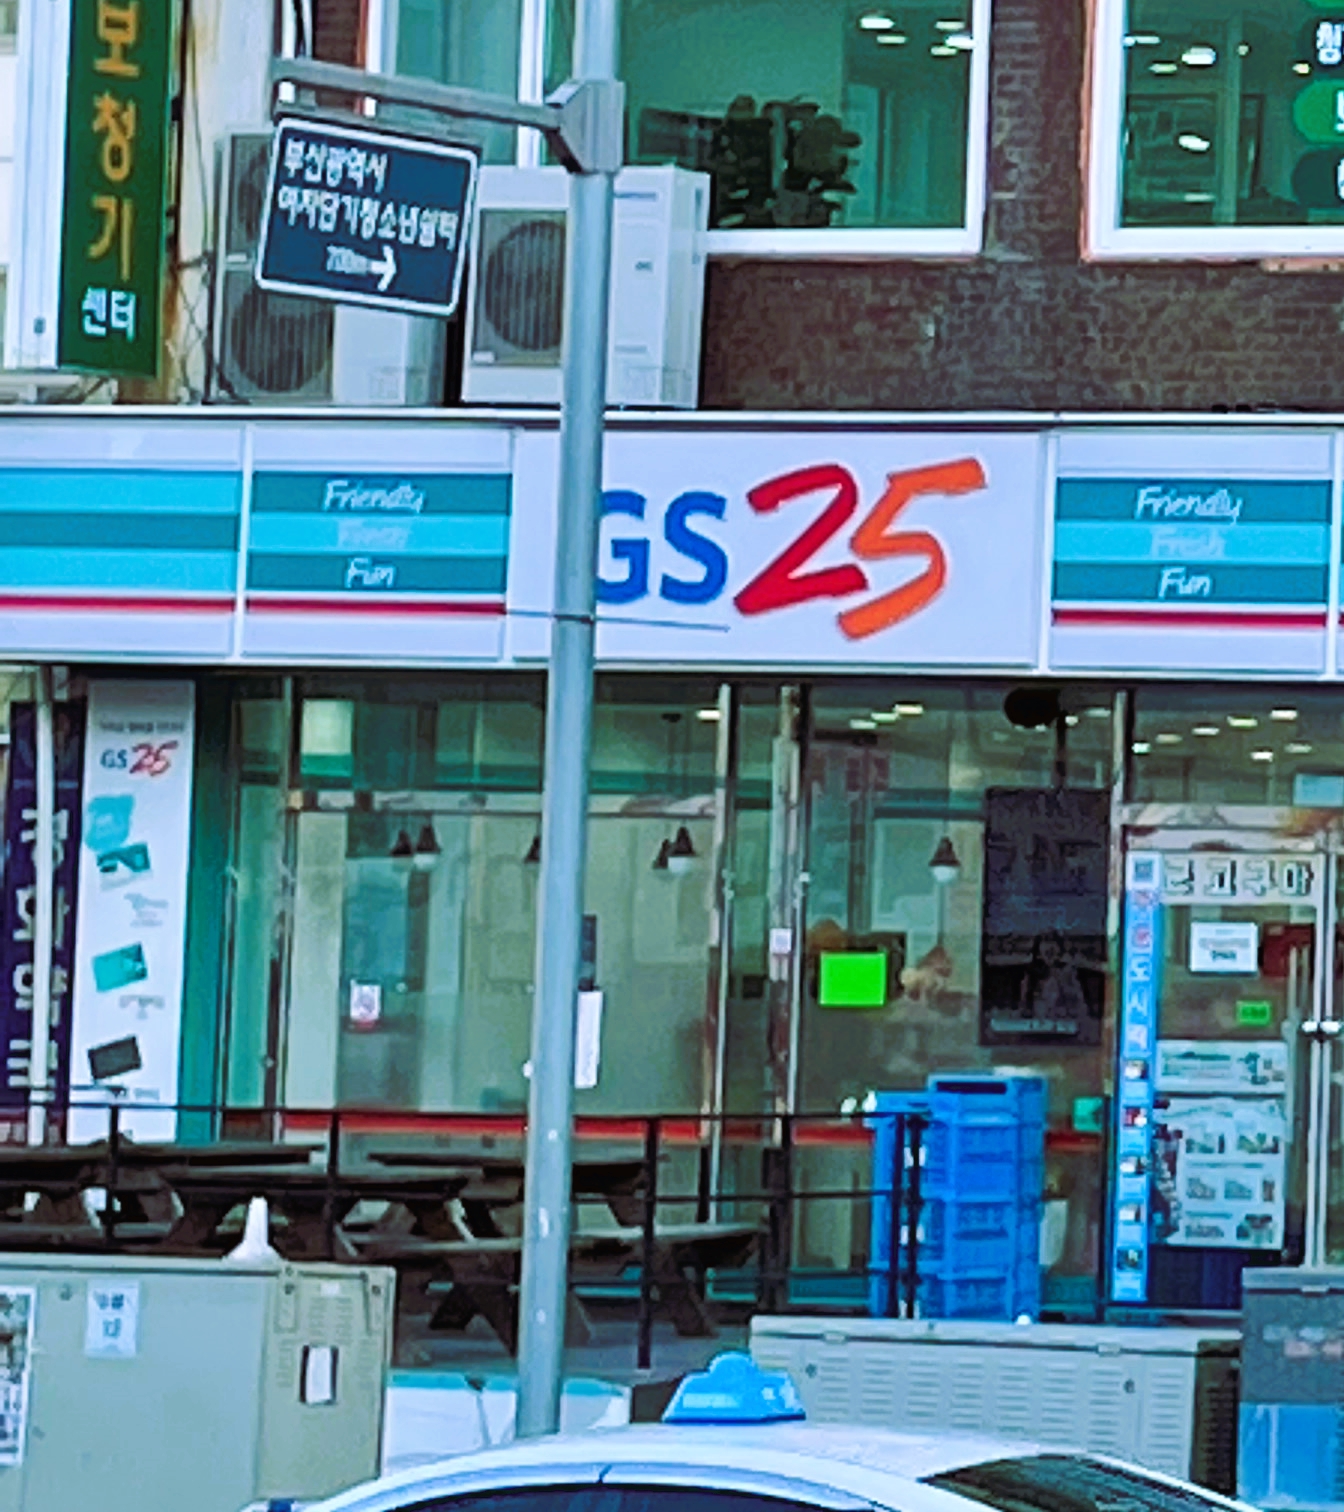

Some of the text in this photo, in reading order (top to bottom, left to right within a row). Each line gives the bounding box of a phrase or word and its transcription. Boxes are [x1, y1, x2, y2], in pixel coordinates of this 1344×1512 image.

[283, 137, 390, 195] 부산광역시
[81, 286, 137, 342] 센터
[322, 478, 425, 516] Friendly
[1133, 485, 1244, 527] Friendly
[594, 456, 987, 639] GS25
[345, 557, 396, 588] Fun
[1157, 567, 1212, 600] Fun
[101, 739, 179, 777] GS25
